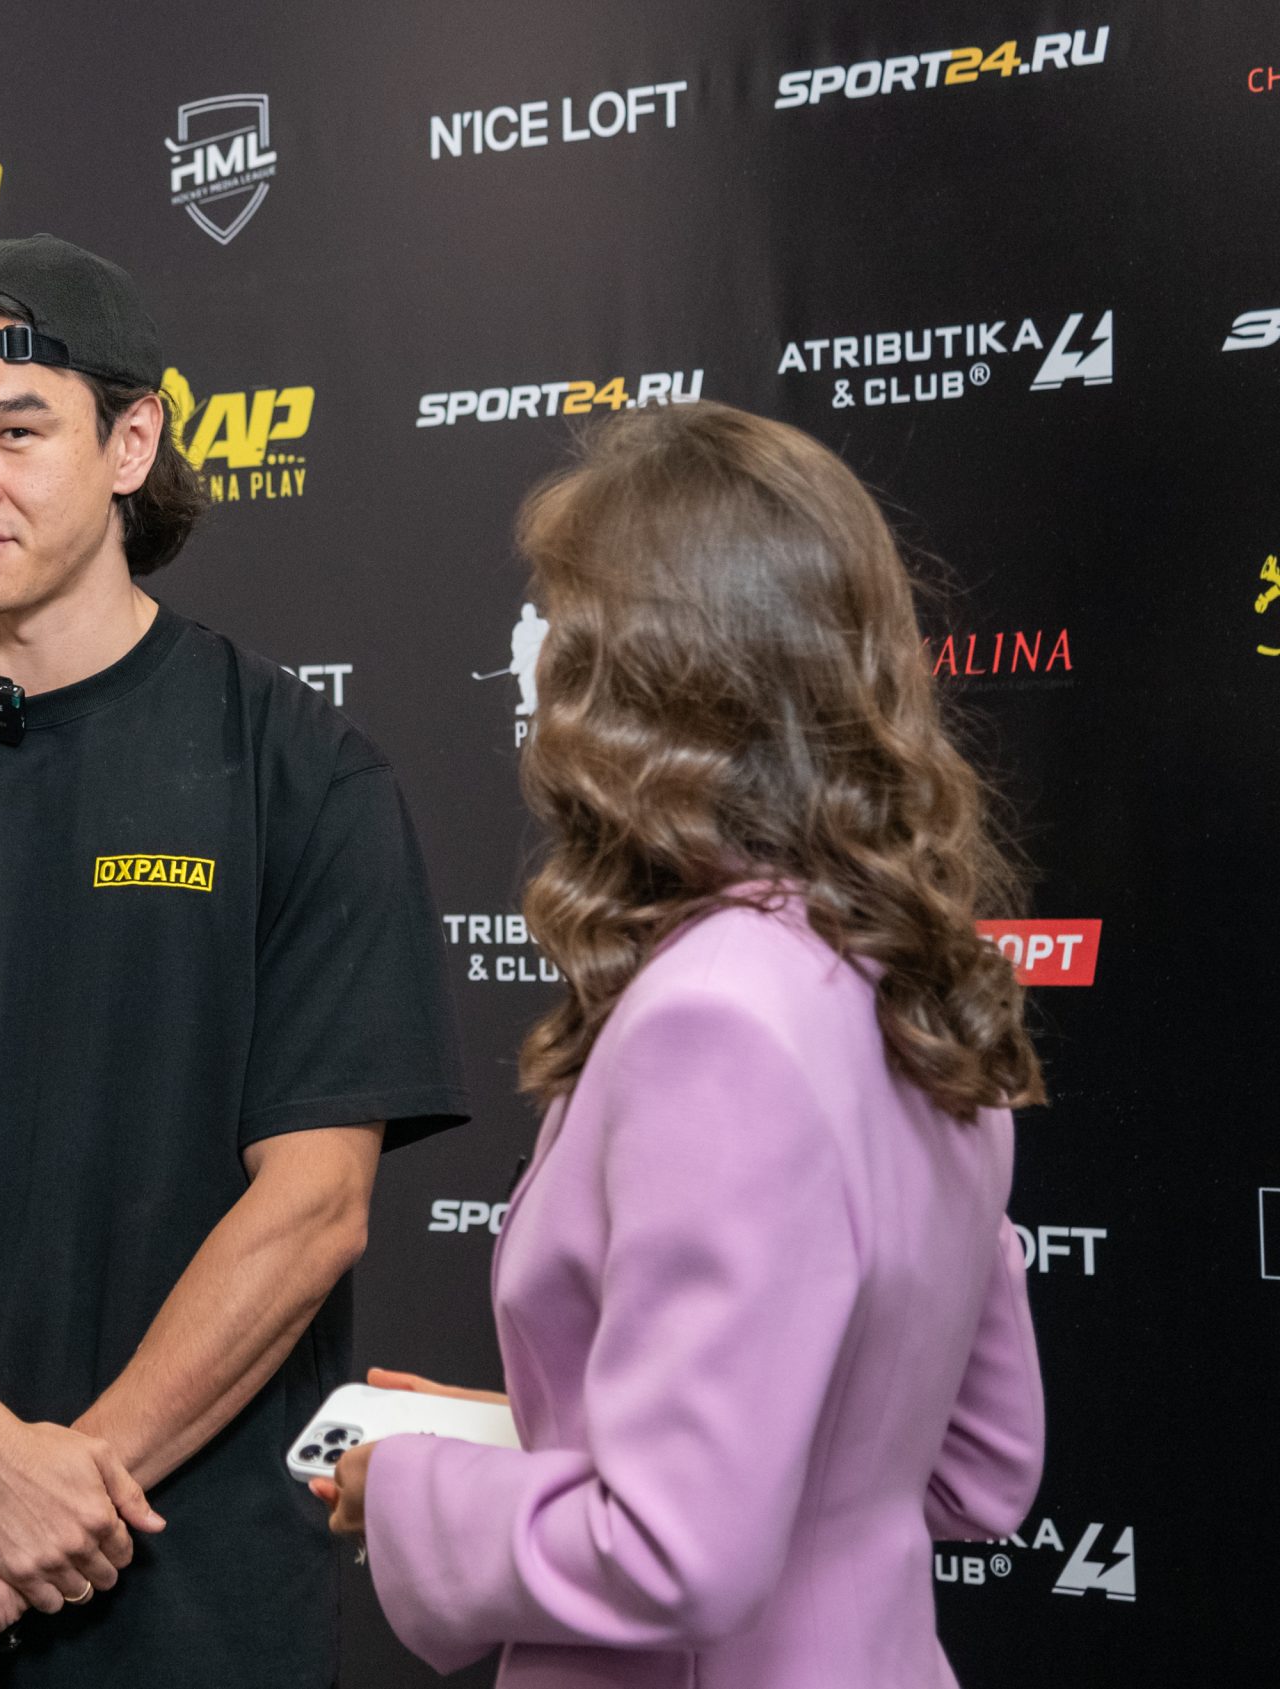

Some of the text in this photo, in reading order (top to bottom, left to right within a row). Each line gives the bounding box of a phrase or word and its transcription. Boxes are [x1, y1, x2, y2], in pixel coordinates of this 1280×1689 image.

[774, 25, 1109, 109] SPORT24.RU
[430, 80, 688, 159] N'ICE LOFT
[171, 131, 277, 192] HML
[777, 318, 1044, 375] ATRIBUTIKA
[415, 369, 704, 428] SPORT24.RU
[832, 379, 856, 409] &
[250, 468, 306, 500] PLAY
[922, 627, 1073, 677] ALINA
[100, 859, 207, 886] ОХРАНА
[442, 914, 541, 945] TRIB
[467, 953, 567, 983] & CLU
